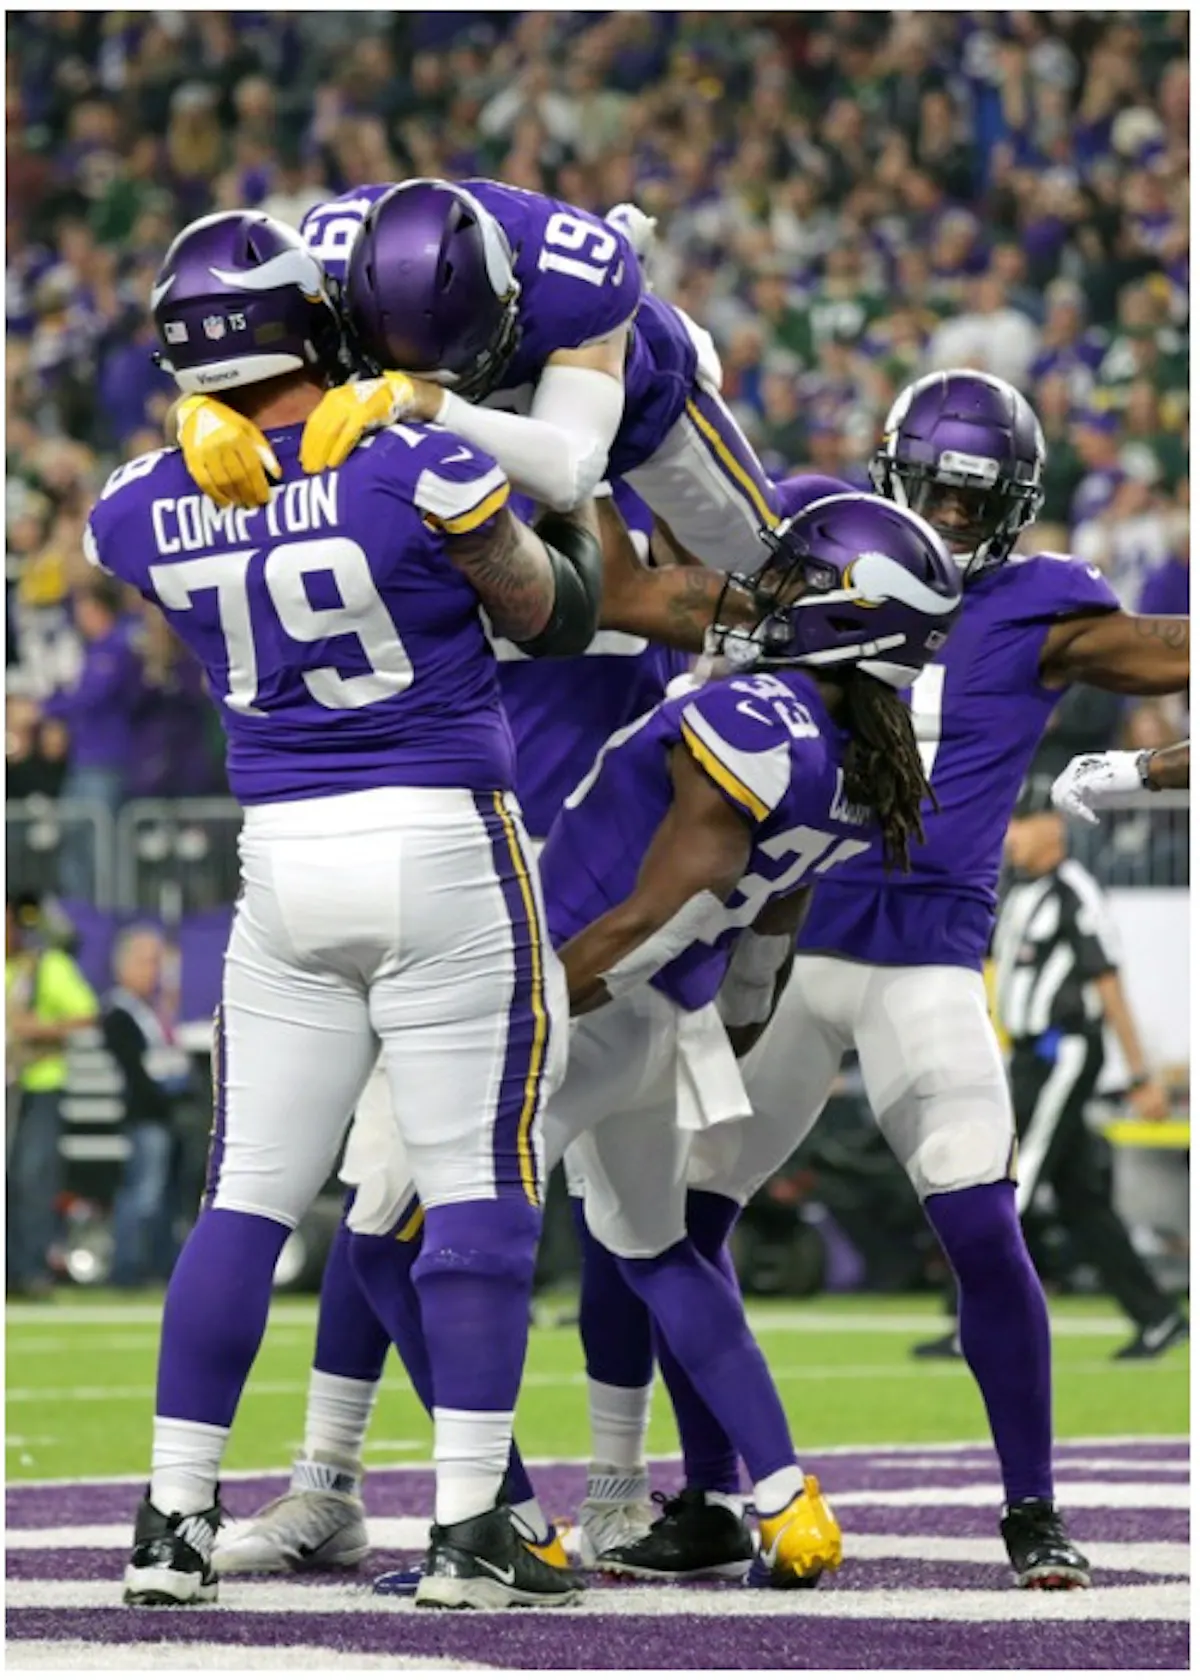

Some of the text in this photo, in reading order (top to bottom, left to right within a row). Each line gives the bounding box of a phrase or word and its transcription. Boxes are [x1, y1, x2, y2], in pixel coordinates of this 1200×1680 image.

[538, 212, 617, 287] 19
[152, 472, 340, 554] COMPTON
[149, 537, 415, 717] 79
[730, 673, 820, 738] 33
